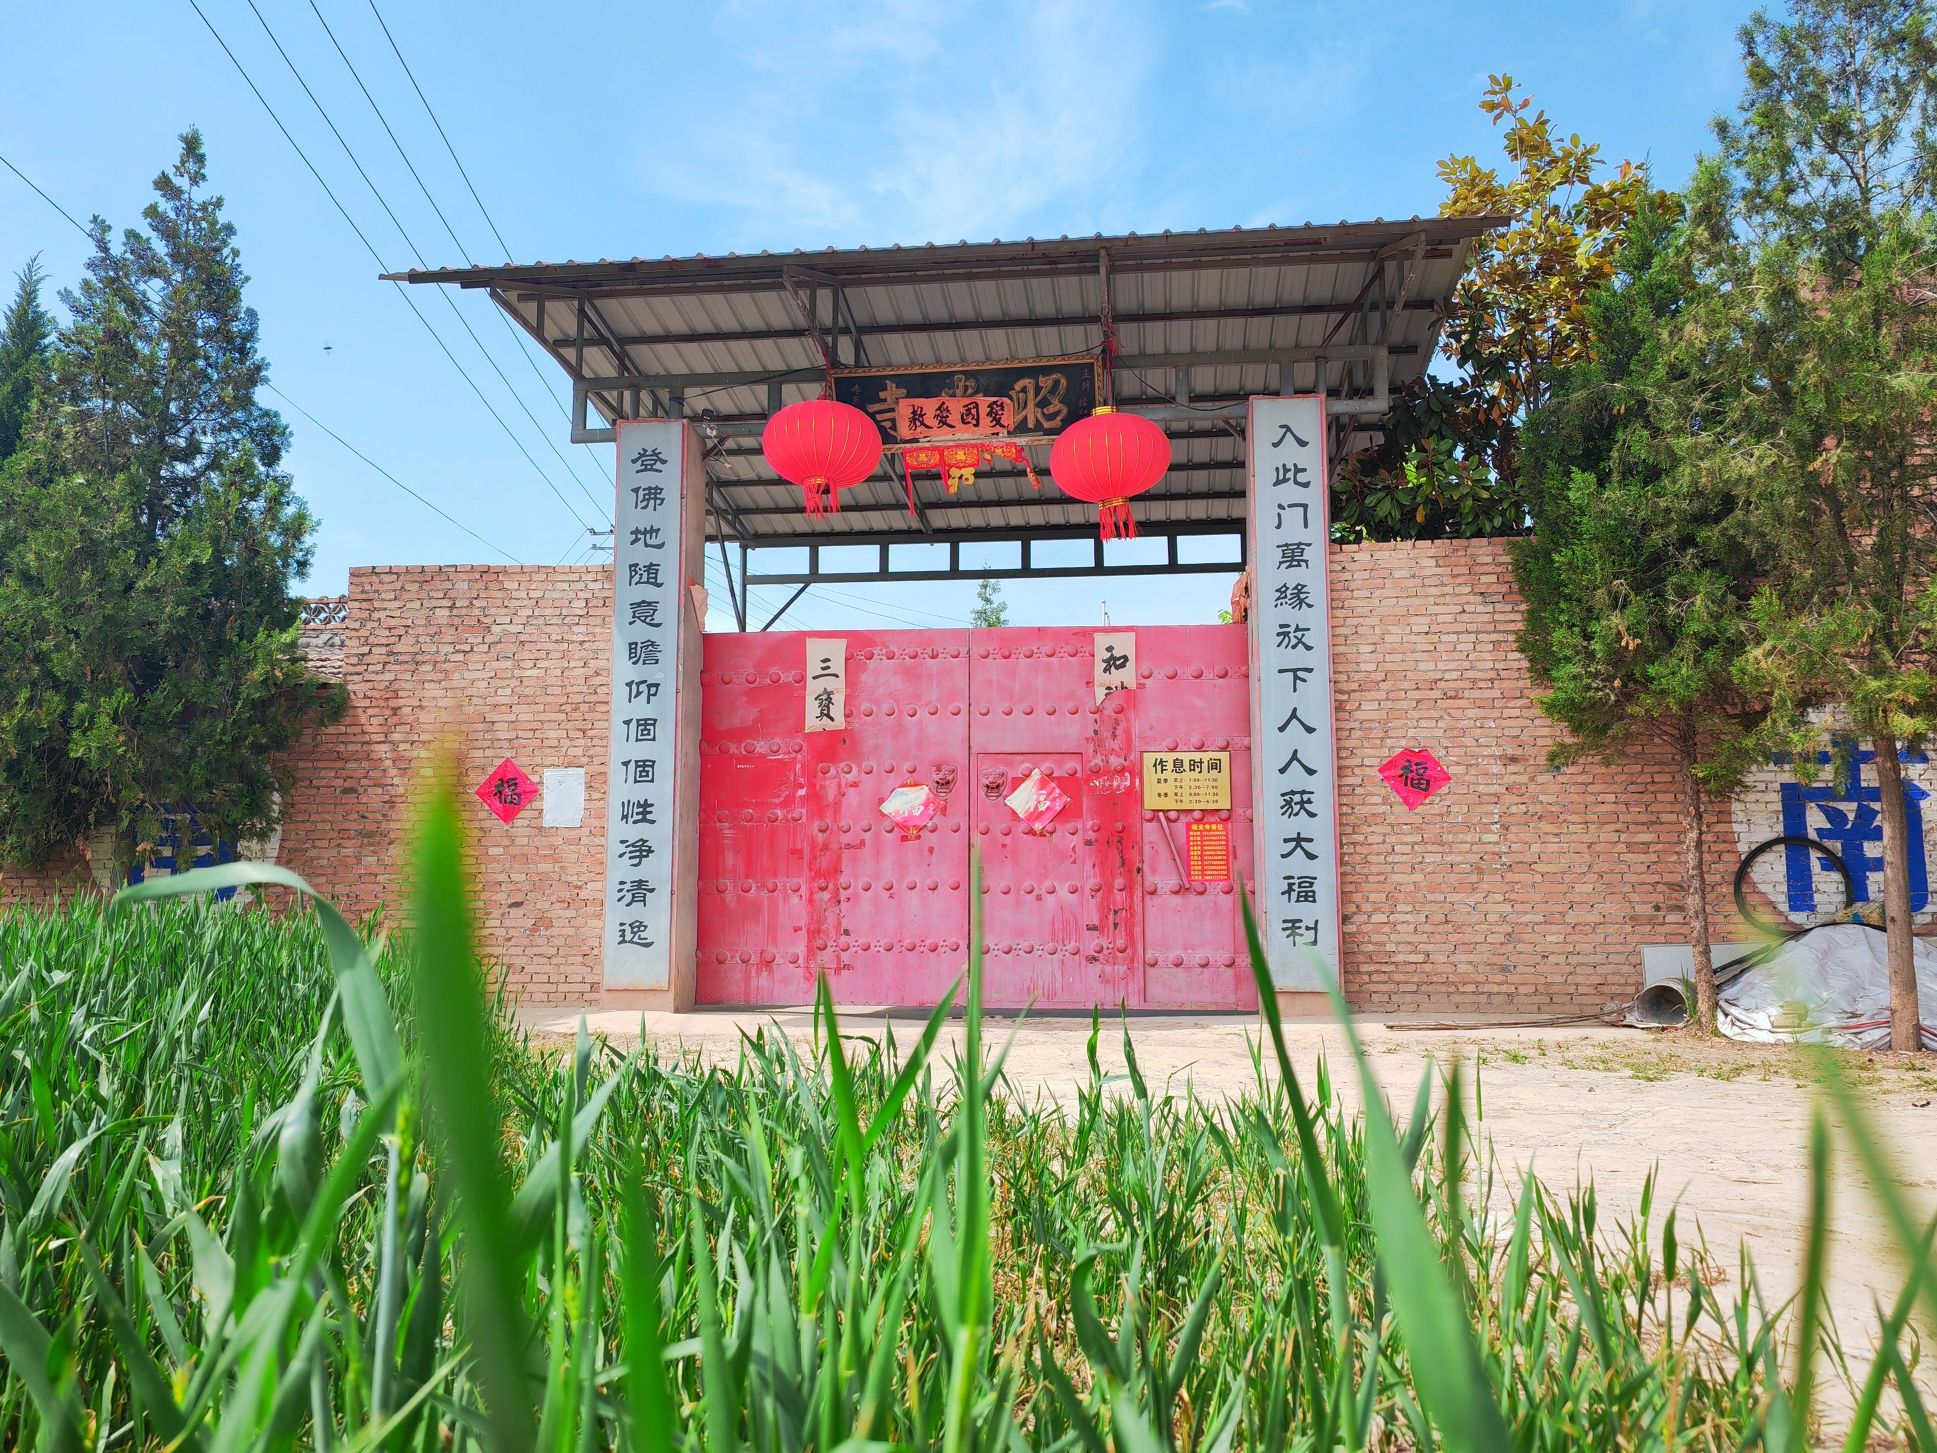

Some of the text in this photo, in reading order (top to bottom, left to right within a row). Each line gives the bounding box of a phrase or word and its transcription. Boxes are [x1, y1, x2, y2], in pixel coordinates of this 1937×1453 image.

[1152, 757, 1222, 775] 作息时间
[1398, 759, 1431, 793] 福
[493, 777, 522, 806] 福
